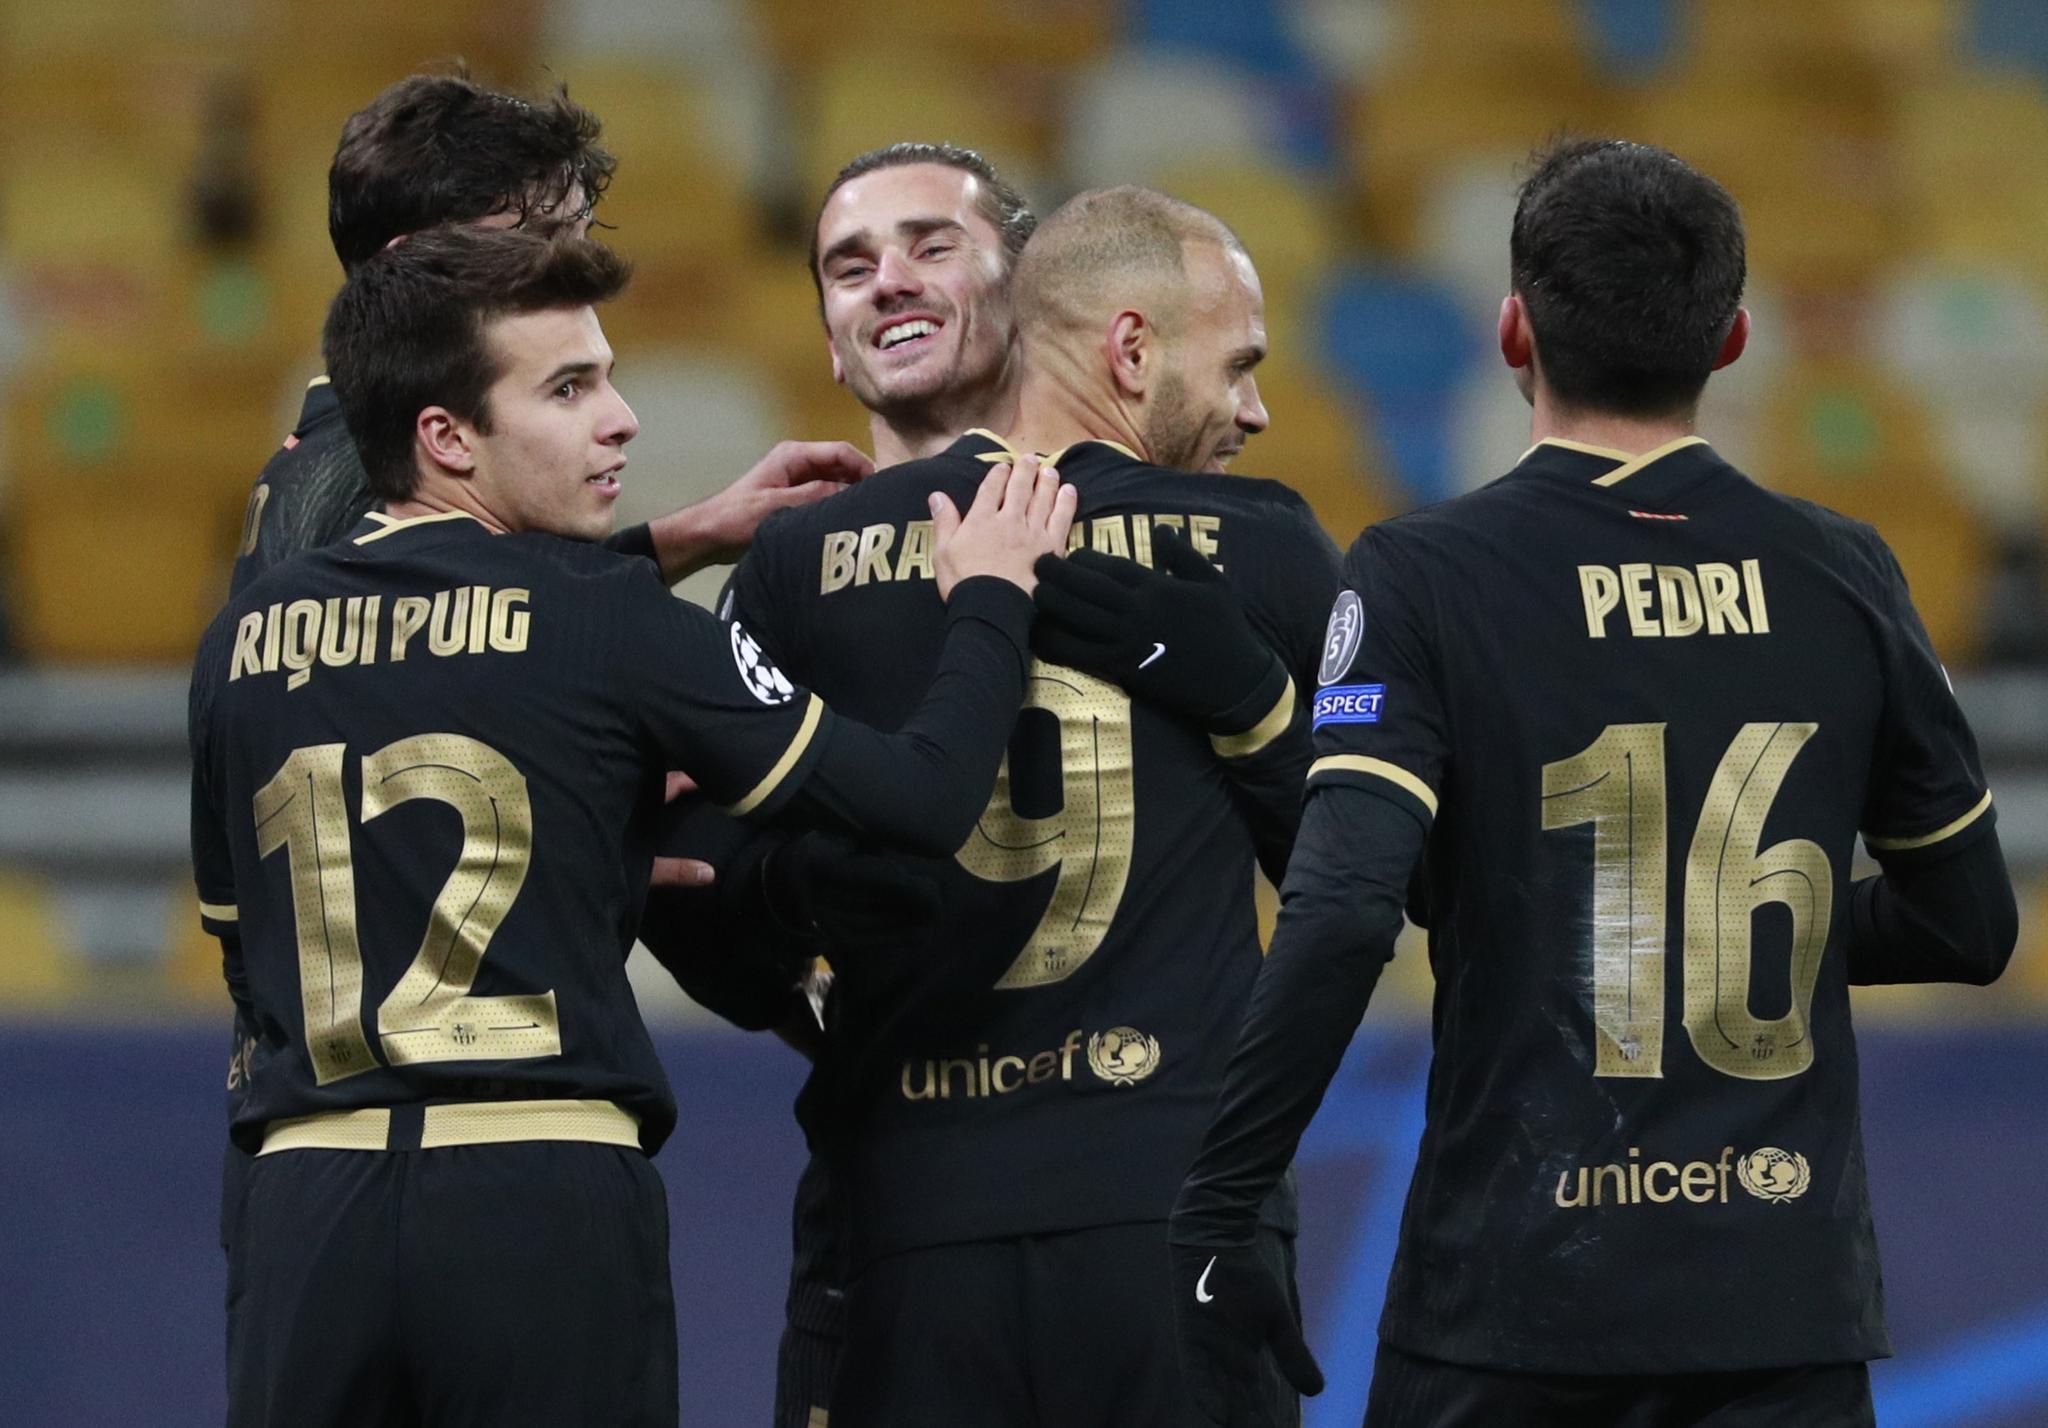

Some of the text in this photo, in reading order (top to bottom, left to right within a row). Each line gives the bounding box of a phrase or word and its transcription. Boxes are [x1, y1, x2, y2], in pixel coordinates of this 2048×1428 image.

[228, 585, 531, 692] RIQUI PUIG
[1577, 558, 1770, 638] PEDRI
[1327, 635, 1342, 661] 5
[954, 656, 1135, 990] 9
[253, 732, 561, 1086] 12
[1541, 722, 1833, 1081] 16
[901, 1029, 1083, 1101] unicef
[1554, 1146, 1734, 1208] unicef
